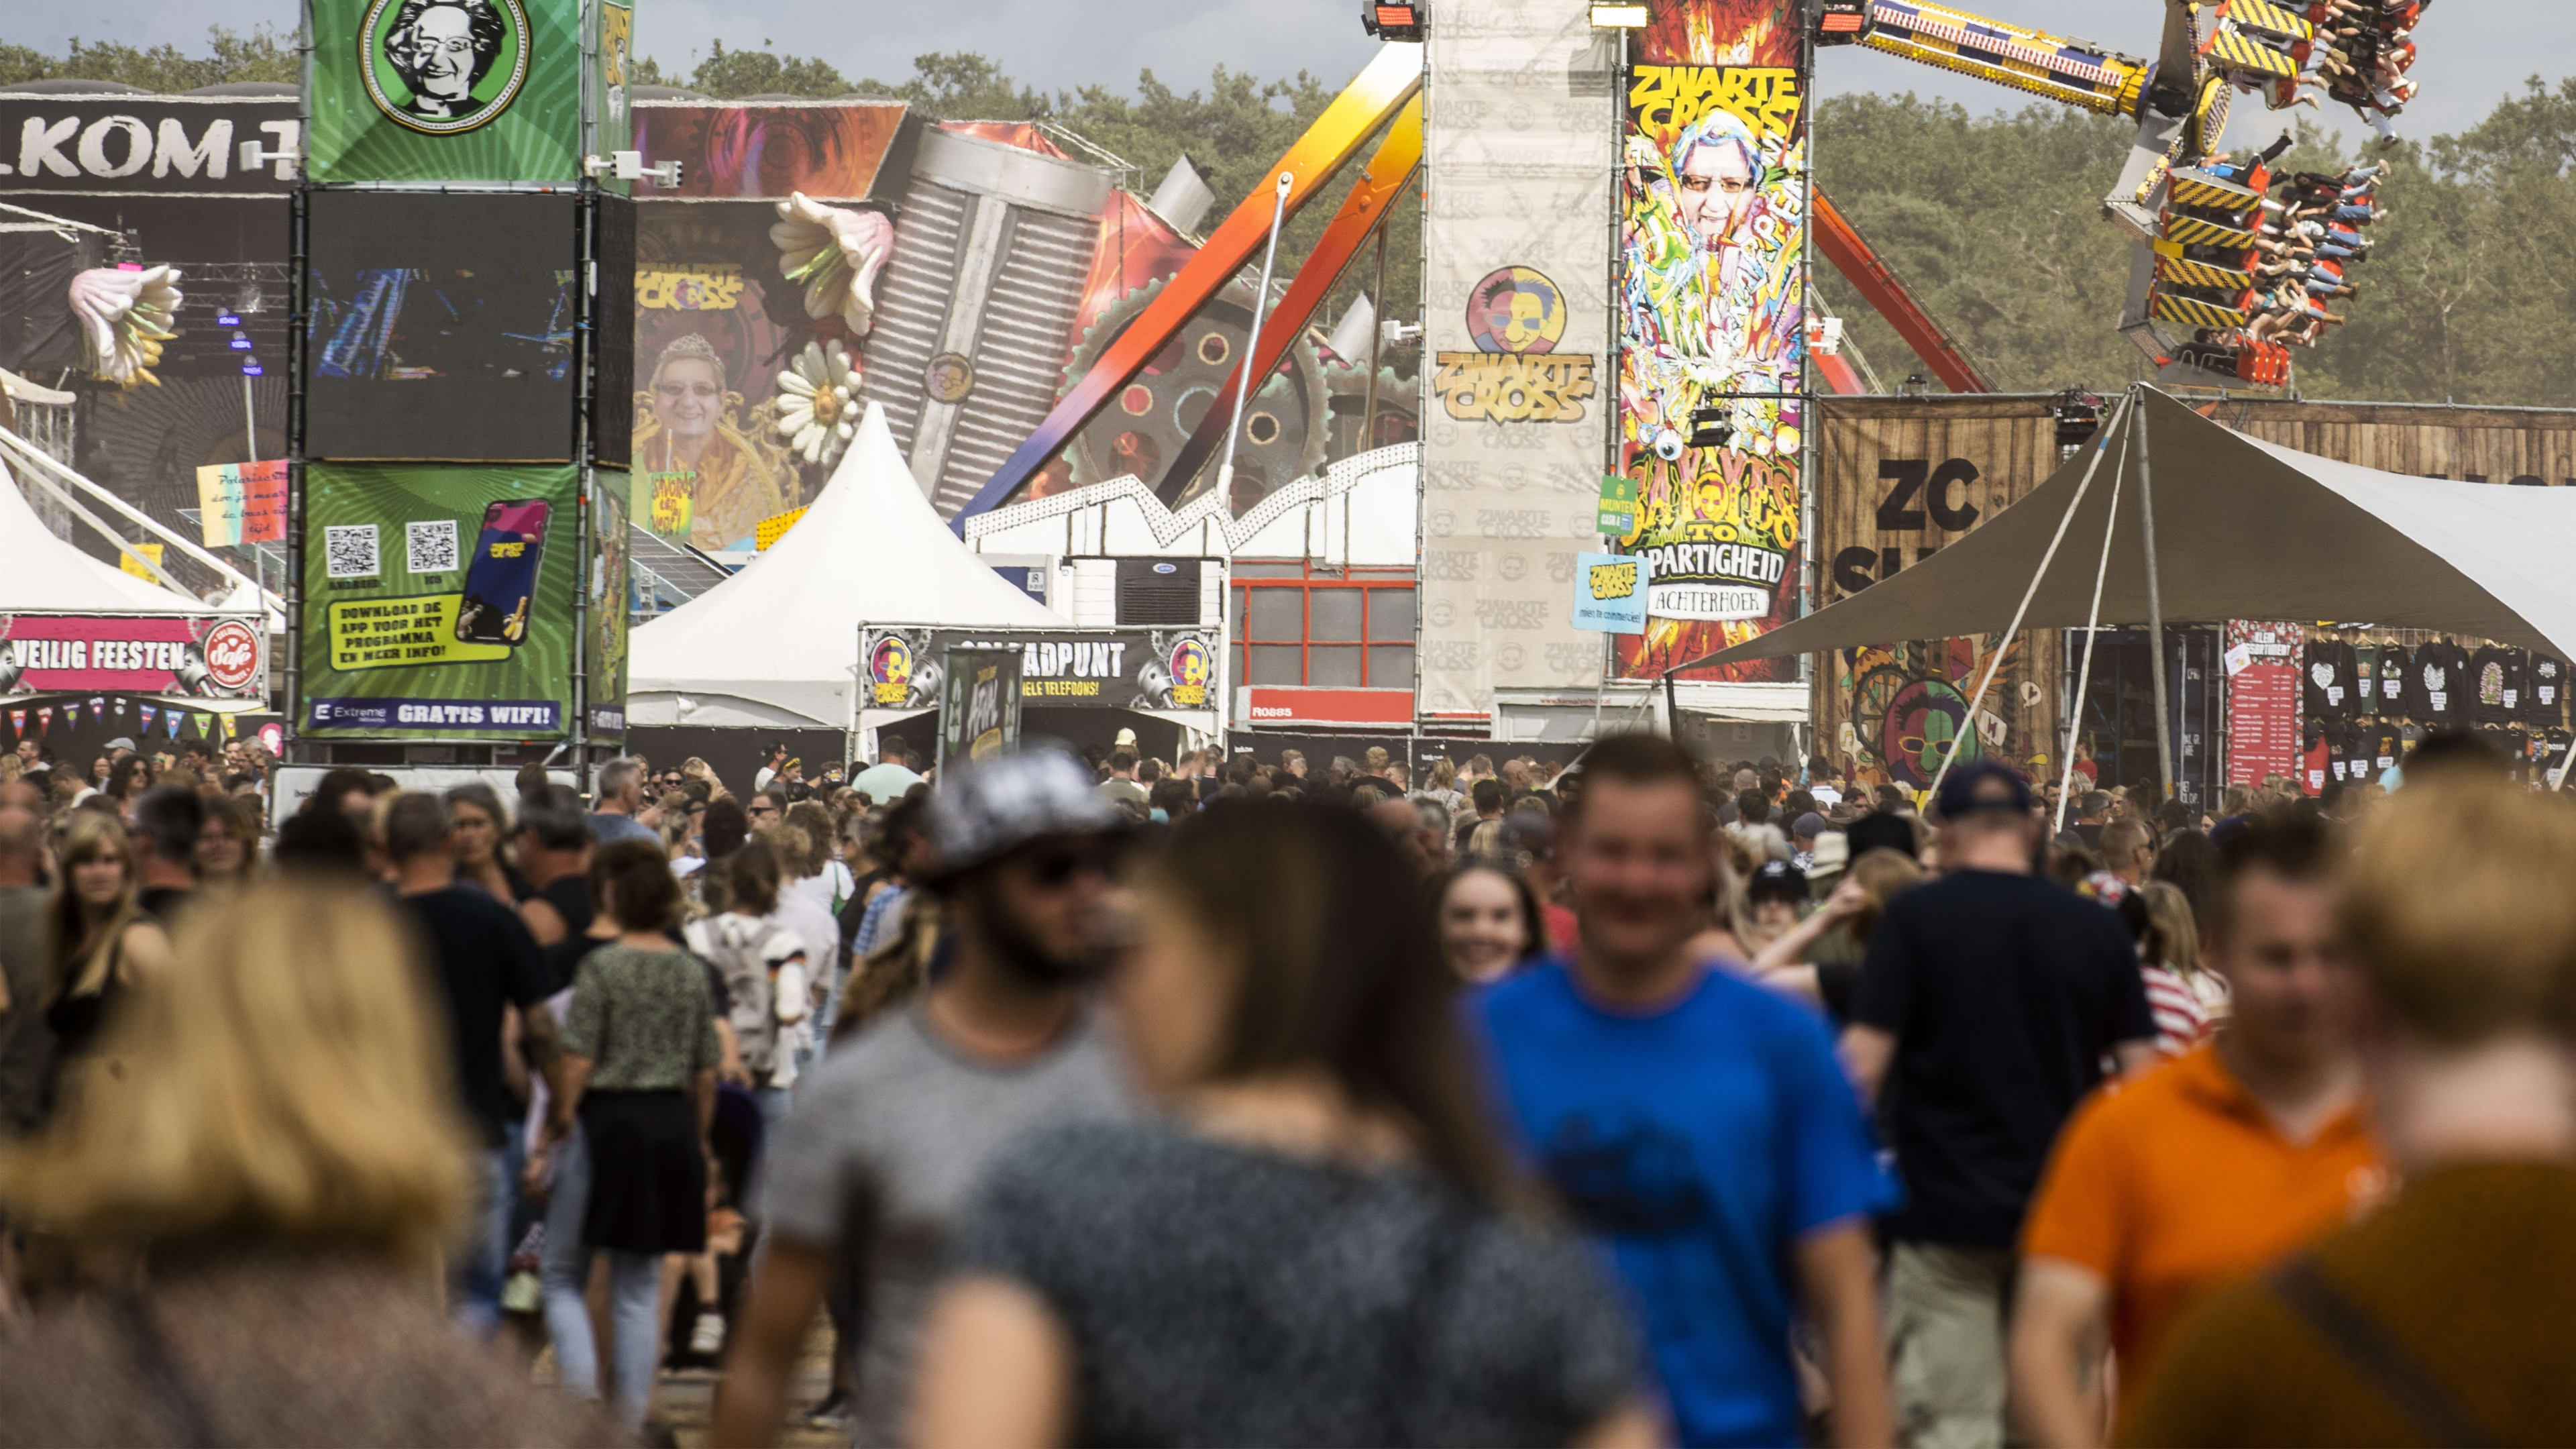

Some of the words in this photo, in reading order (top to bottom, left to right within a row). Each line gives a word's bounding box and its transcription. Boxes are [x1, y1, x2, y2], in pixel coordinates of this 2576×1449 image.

[1629, 65, 1796, 107] ZWARTE
[0, 116, 233, 179] KOM
[1434, 352, 1597, 397] ZWARTE
[1444, 380, 1586, 427] CROSS
[1876, 458, 1980, 532] ZC
[1599, 498, 1637, 515] MUNTEN
[1477, 510, 1552, 529] ZWARTE
[1481, 523, 1547, 541] CROSS
[1689, 523, 1738, 541] TO
[1590, 561, 1637, 587] ZWARTE
[1592, 578, 1633, 601] CROSS
[340, 604, 419, 619] DOWNLOAD
[424, 602, 441, 614] DE
[1475, 600, 1549, 617] ZWARTE
[1654, 591, 1759, 612] ACHTERHOEK
[340, 623, 368, 634] APP
[373, 619, 409, 632] VOOR
[414, 616, 443, 628] HET
[1481, 614, 1545, 630] CROSS
[345, 631, 435, 648] PROGRAMMA
[12, 639, 88, 670] VEILIG
[92, 640, 186, 671] FEESTEN
[210, 642, 252, 671] Safe
[340, 653, 357, 663] EN
[363, 648, 400, 661] MEER
[407, 645, 446, 658] INFO!
[2247, 643, 2291, 656] SSORTIMENT
[1044, 681, 1099, 696] TELEFOONS!
[335, 706, 387, 718] Extreme
[397, 704, 484, 724] GRATIS
[490, 706, 551, 724] WIFI!
